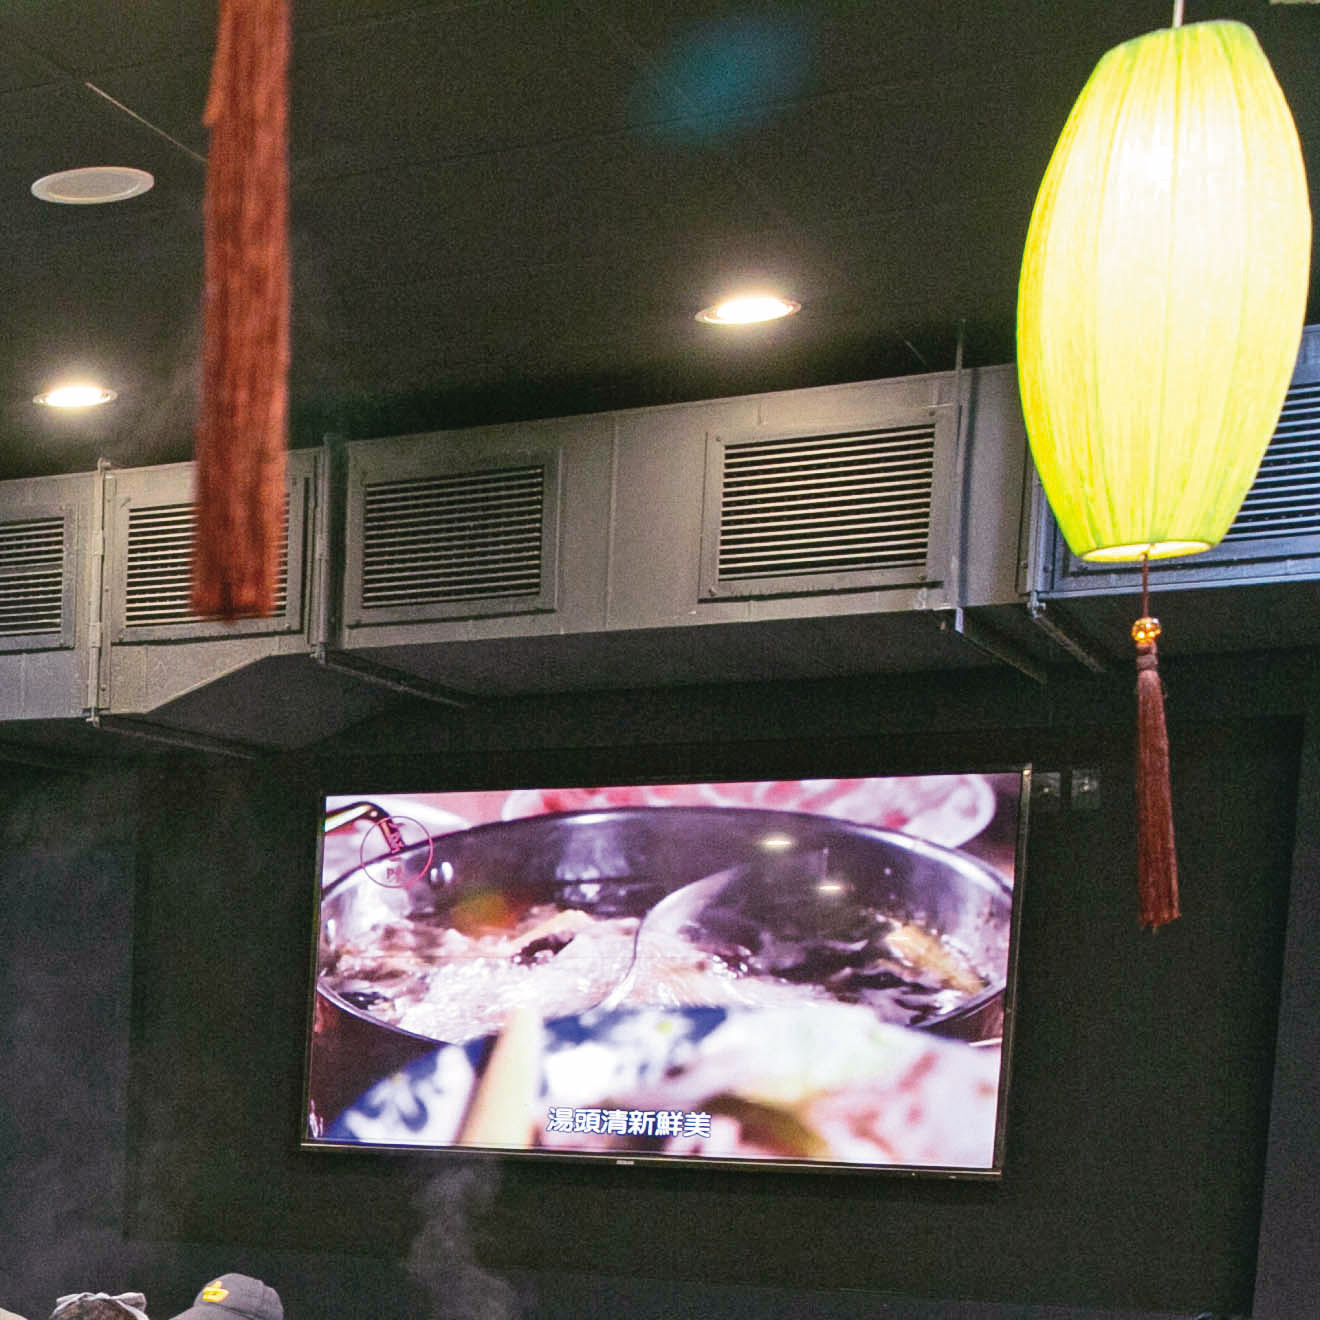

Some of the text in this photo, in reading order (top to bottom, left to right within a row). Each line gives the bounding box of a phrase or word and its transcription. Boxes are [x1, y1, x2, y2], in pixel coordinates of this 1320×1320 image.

[546, 1107, 712, 1138] 湯頭清新鮮美
